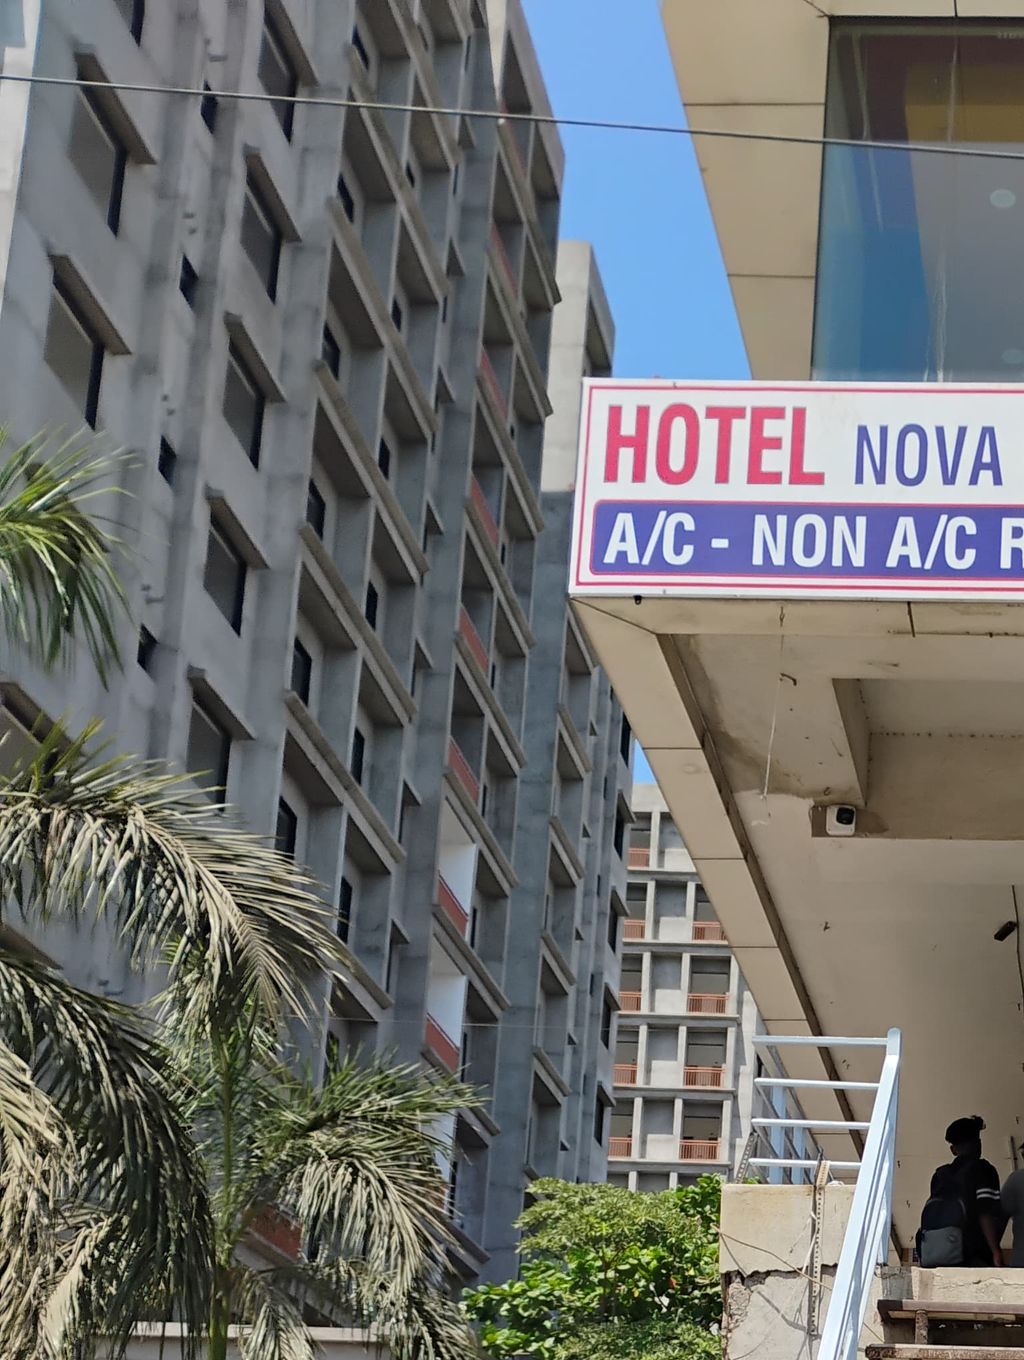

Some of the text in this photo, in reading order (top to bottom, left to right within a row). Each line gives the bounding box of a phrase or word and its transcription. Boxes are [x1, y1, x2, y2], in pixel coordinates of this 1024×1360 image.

[603, 403, 825, 486] HOTEL
[855, 423, 1002, 487] NOVA
[602, 510, 695, 567] A/C
[711, 538, 729, 549] -
[752, 514, 865, 568] NON
[885, 515, 977, 570] A/C
